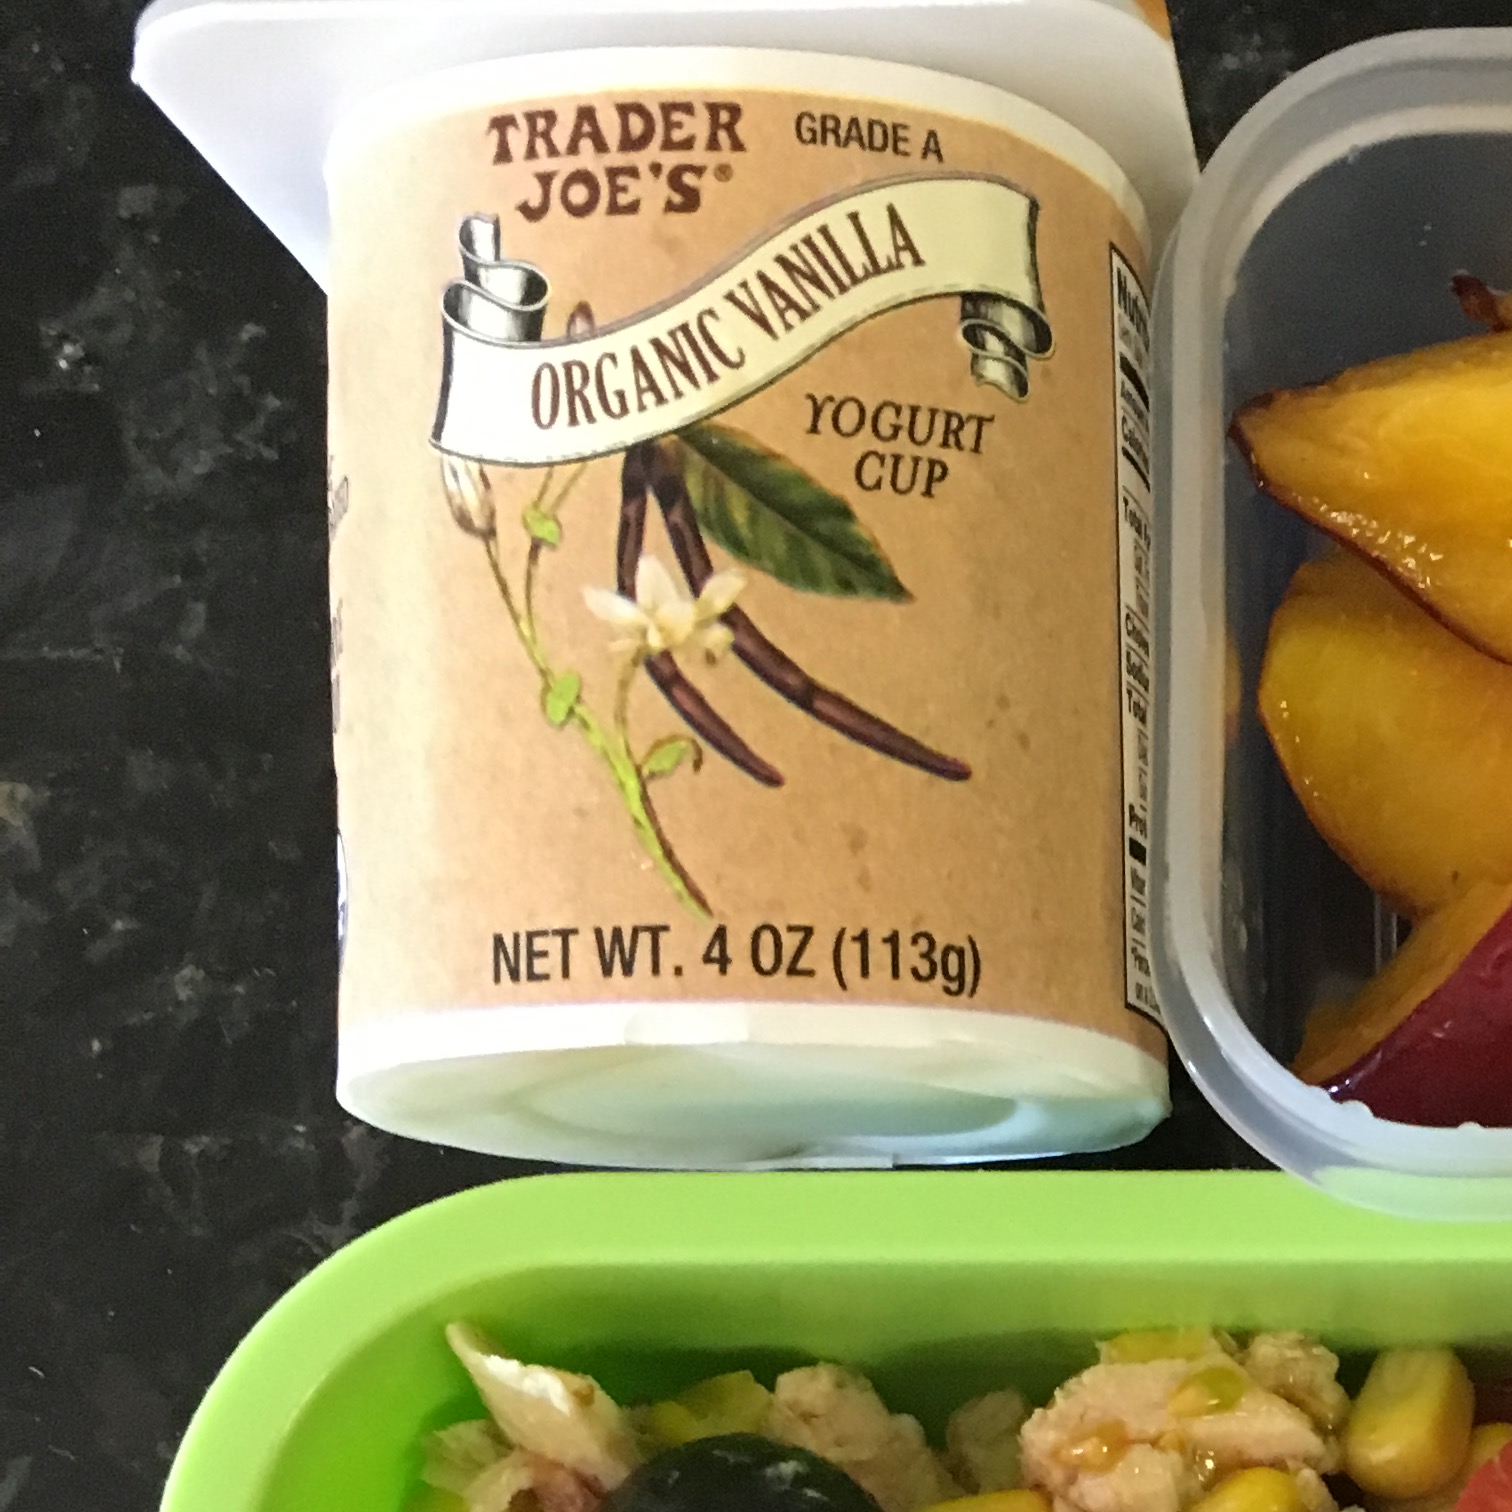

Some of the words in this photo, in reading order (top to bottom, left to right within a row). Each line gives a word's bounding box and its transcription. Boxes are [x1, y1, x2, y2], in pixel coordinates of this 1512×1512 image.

[486, 101, 747, 166] TRADER
[795, 112, 910, 157] GRADE
[921, 130, 945, 163] A
[531, 308, 746, 430] ORGANIC
[723, 202, 926, 343] VANILLA
[805, 393, 995, 455] YOGURT
[854, 449, 950, 500] CUP
[493, 927, 579, 985] NET
[594, 924, 684, 977] WT.
[702, 923, 732, 976] 4
[750, 923, 816, 977] OZ
[832, 927, 982, 998] (113g)
